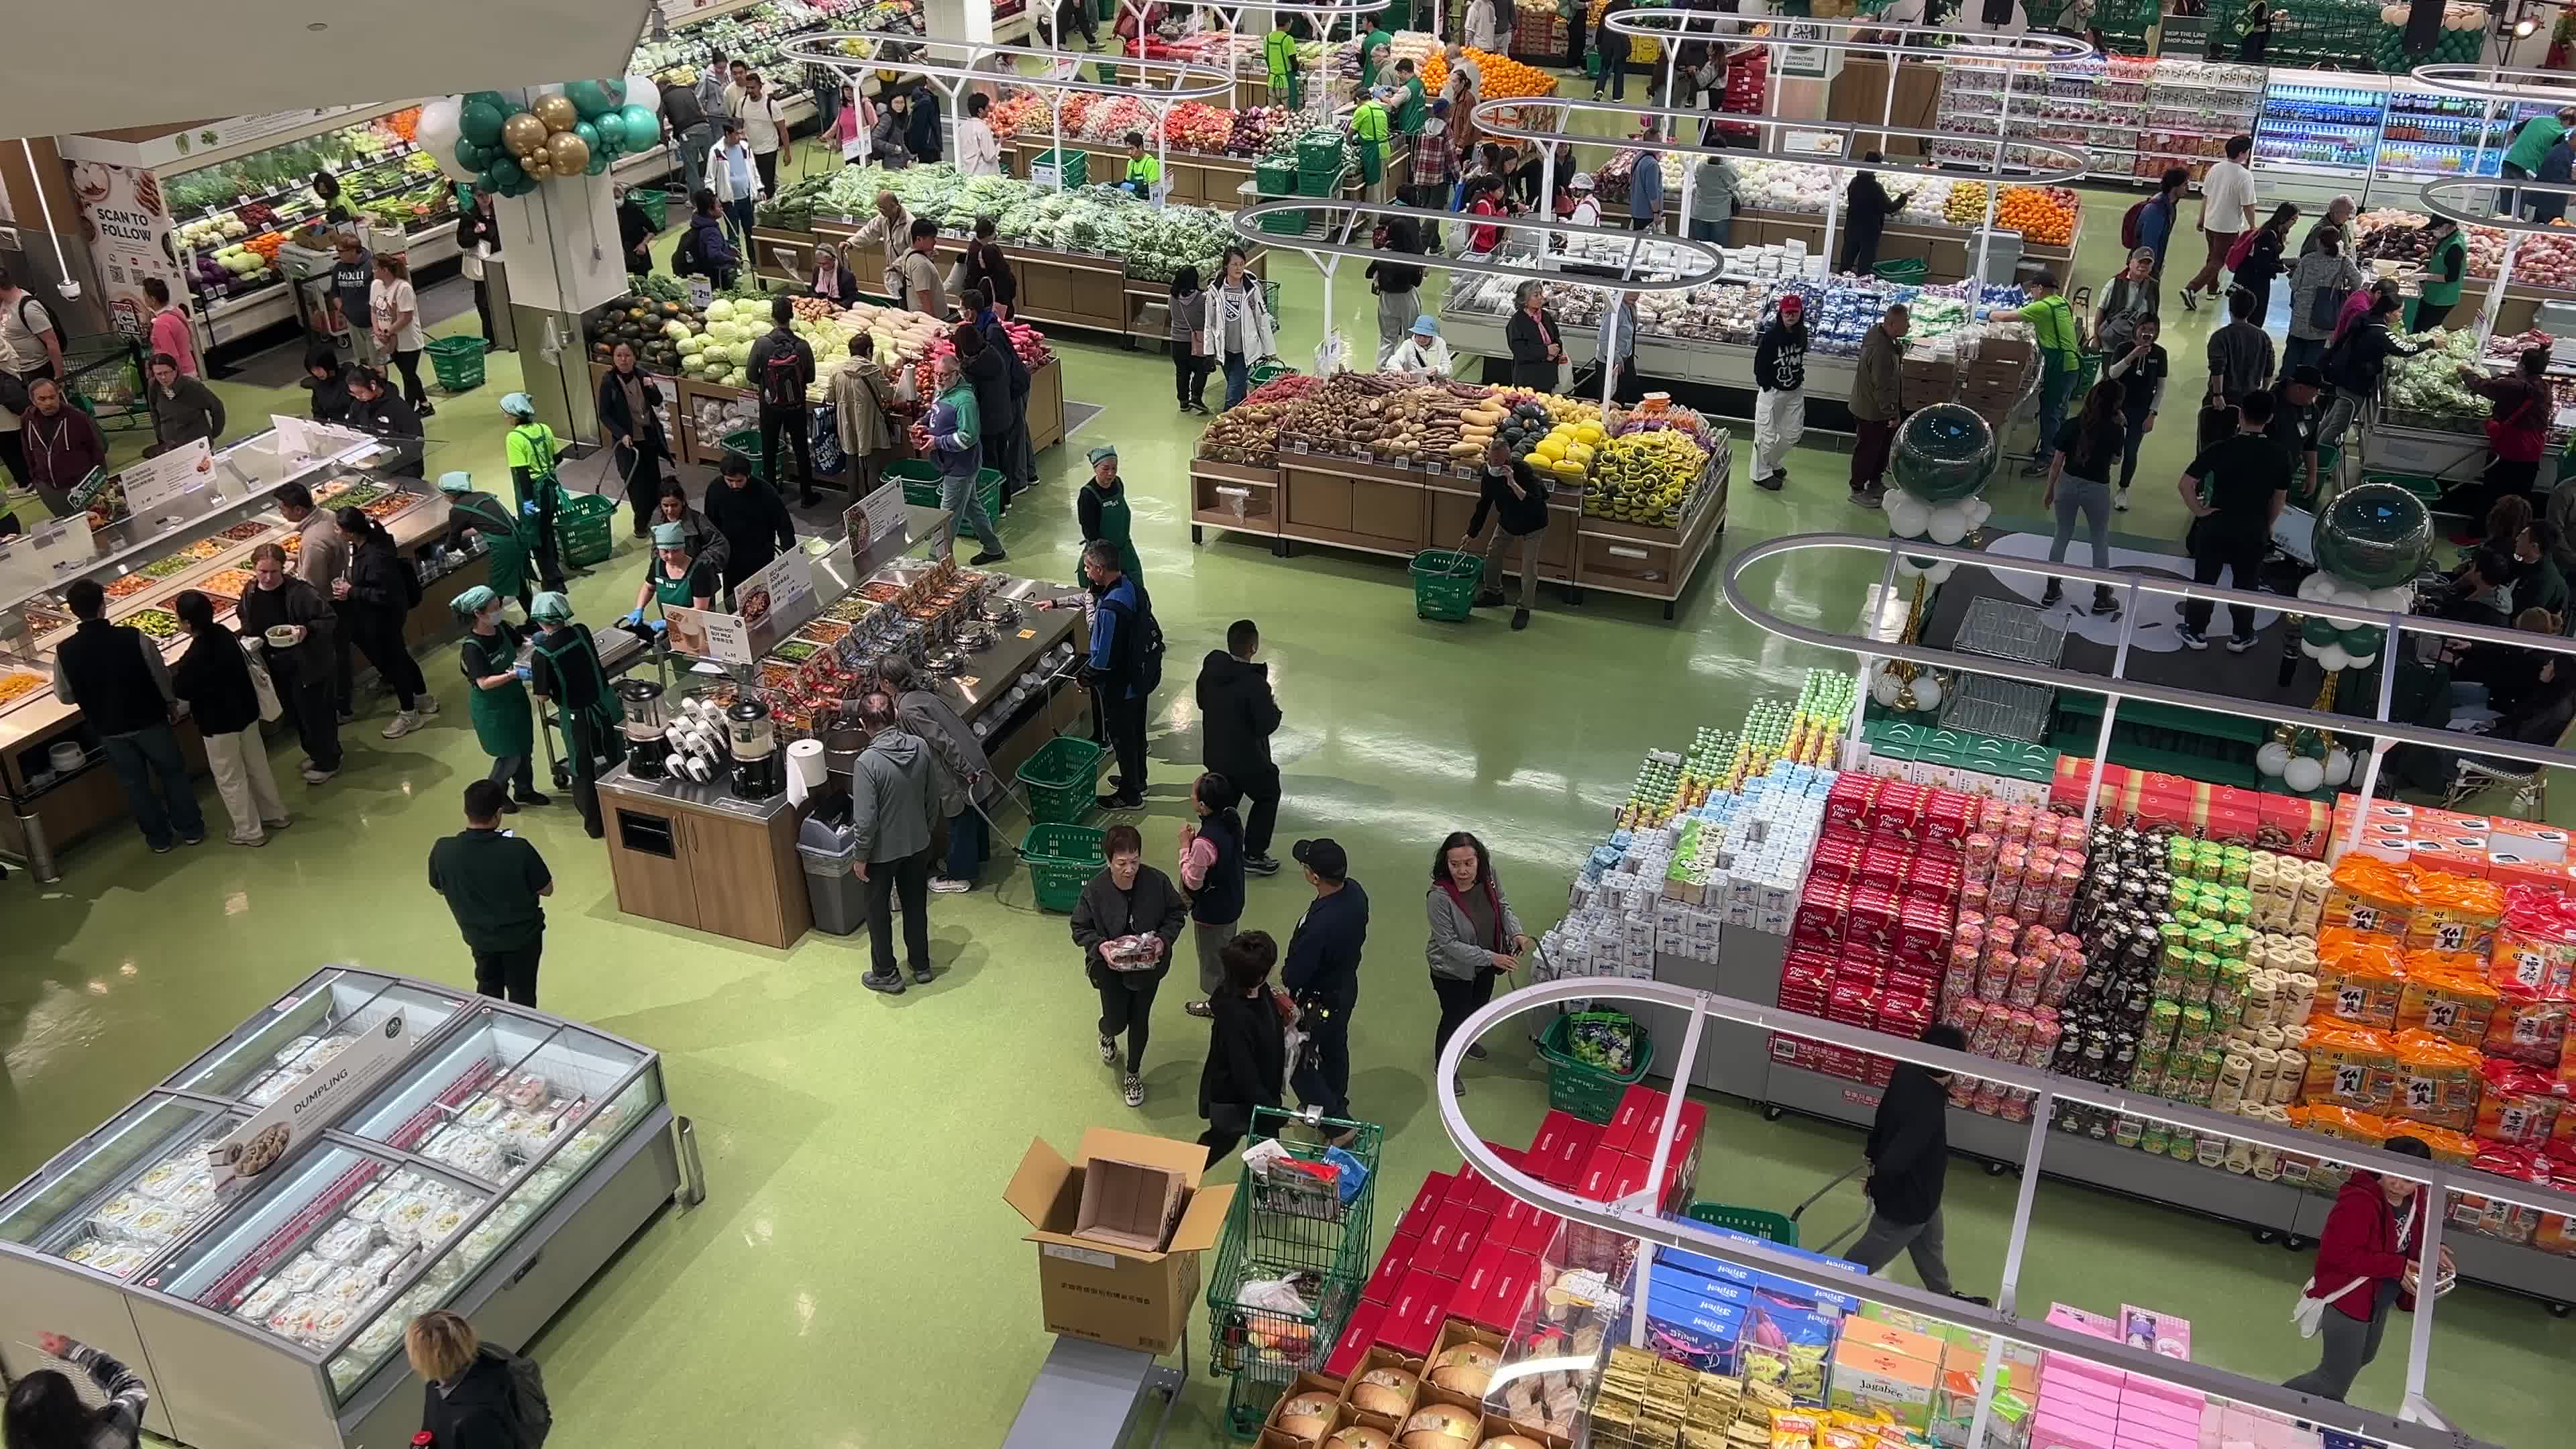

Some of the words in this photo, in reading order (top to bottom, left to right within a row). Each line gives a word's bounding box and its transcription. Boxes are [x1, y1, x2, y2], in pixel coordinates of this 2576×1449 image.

[97, 208, 131, 225] SCAN
[131, 213, 148, 226] TO
[101, 223, 151, 242] FOLLOW
[1832, 804, 1856, 814] Choco
[1832, 810, 1845, 818] Pie
[1880, 813, 1904, 824] Choco
[1880, 820, 1894, 828] Pie
[1929, 822, 1954, 833] Choco
[1929, 830, 1943, 838] Pie
[1816, 869, 1840, 879] Choco
[1864, 879, 1888, 890] Choco
[1913, 889, 1938, 900] Choco
[1802, 917, 1816, 926] Pie
[1803, 911, 1827, 922] Choco
[1853, 916, 1878, 926] Choco
[1853, 922, 1868, 930] Pie
[1904, 941, 1919, 949] Pie
[1905, 934, 1930, 946] Choco
[294, 1068, 349, 1114] DUMPLING
[1859, 1379, 1904, 1399] Jagabee
